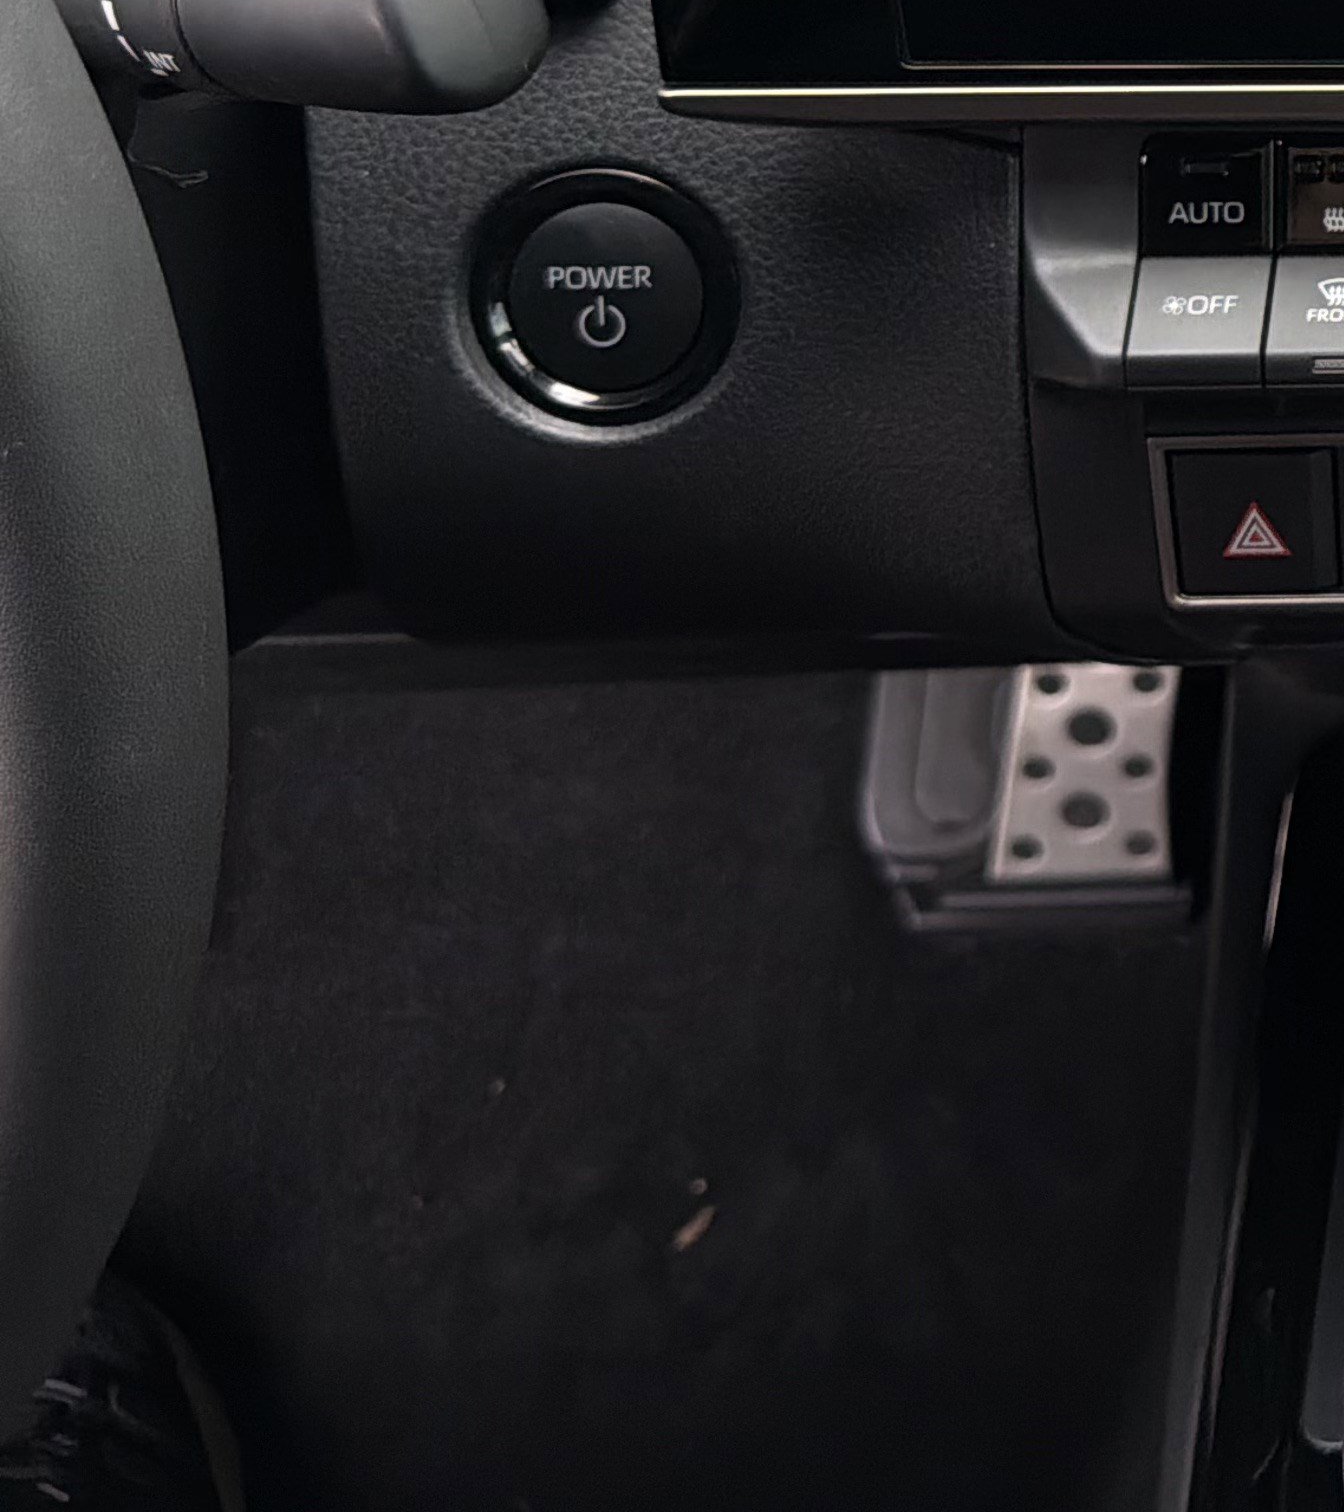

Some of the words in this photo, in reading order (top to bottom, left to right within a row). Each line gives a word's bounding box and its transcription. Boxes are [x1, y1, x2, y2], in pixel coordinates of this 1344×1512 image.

[1168, 201, 1245, 225] AUTO
[547, 265, 652, 290] POWER
[1187, 295, 1239, 316] OFF
